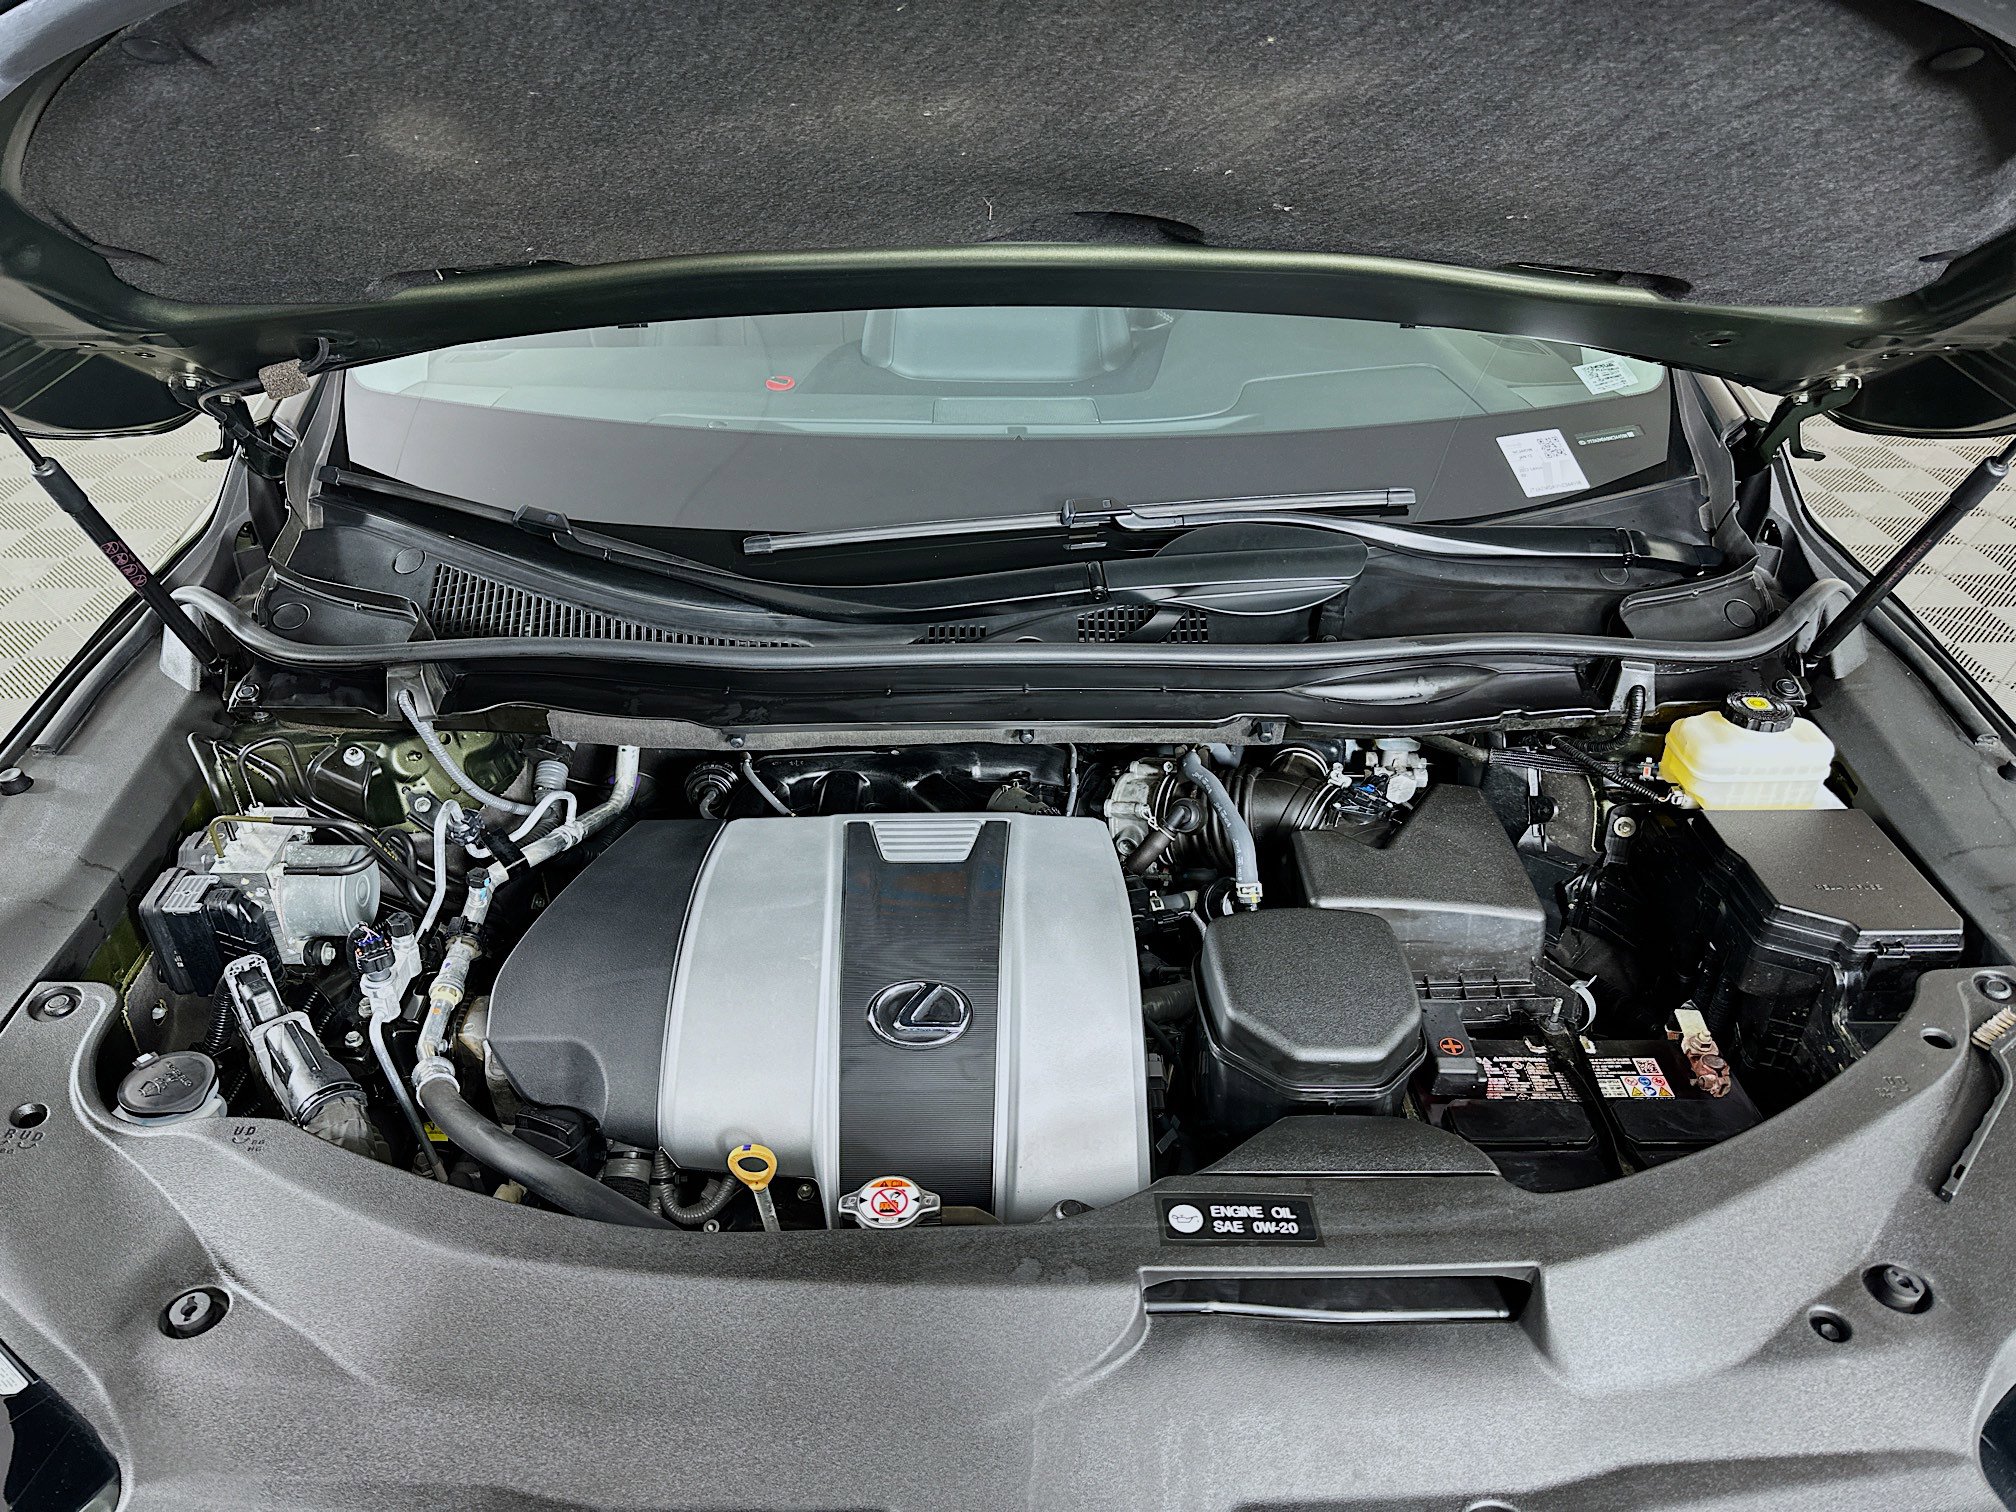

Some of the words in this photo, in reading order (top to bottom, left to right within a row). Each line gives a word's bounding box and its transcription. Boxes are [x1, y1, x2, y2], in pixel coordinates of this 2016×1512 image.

[1209, 1205, 1264, 1218] ENGINE
[1270, 1206, 1297, 1219] OIL
[1213, 1220, 1245, 1233] SAE
[1252, 1221, 1299, 1234] 0W-20
